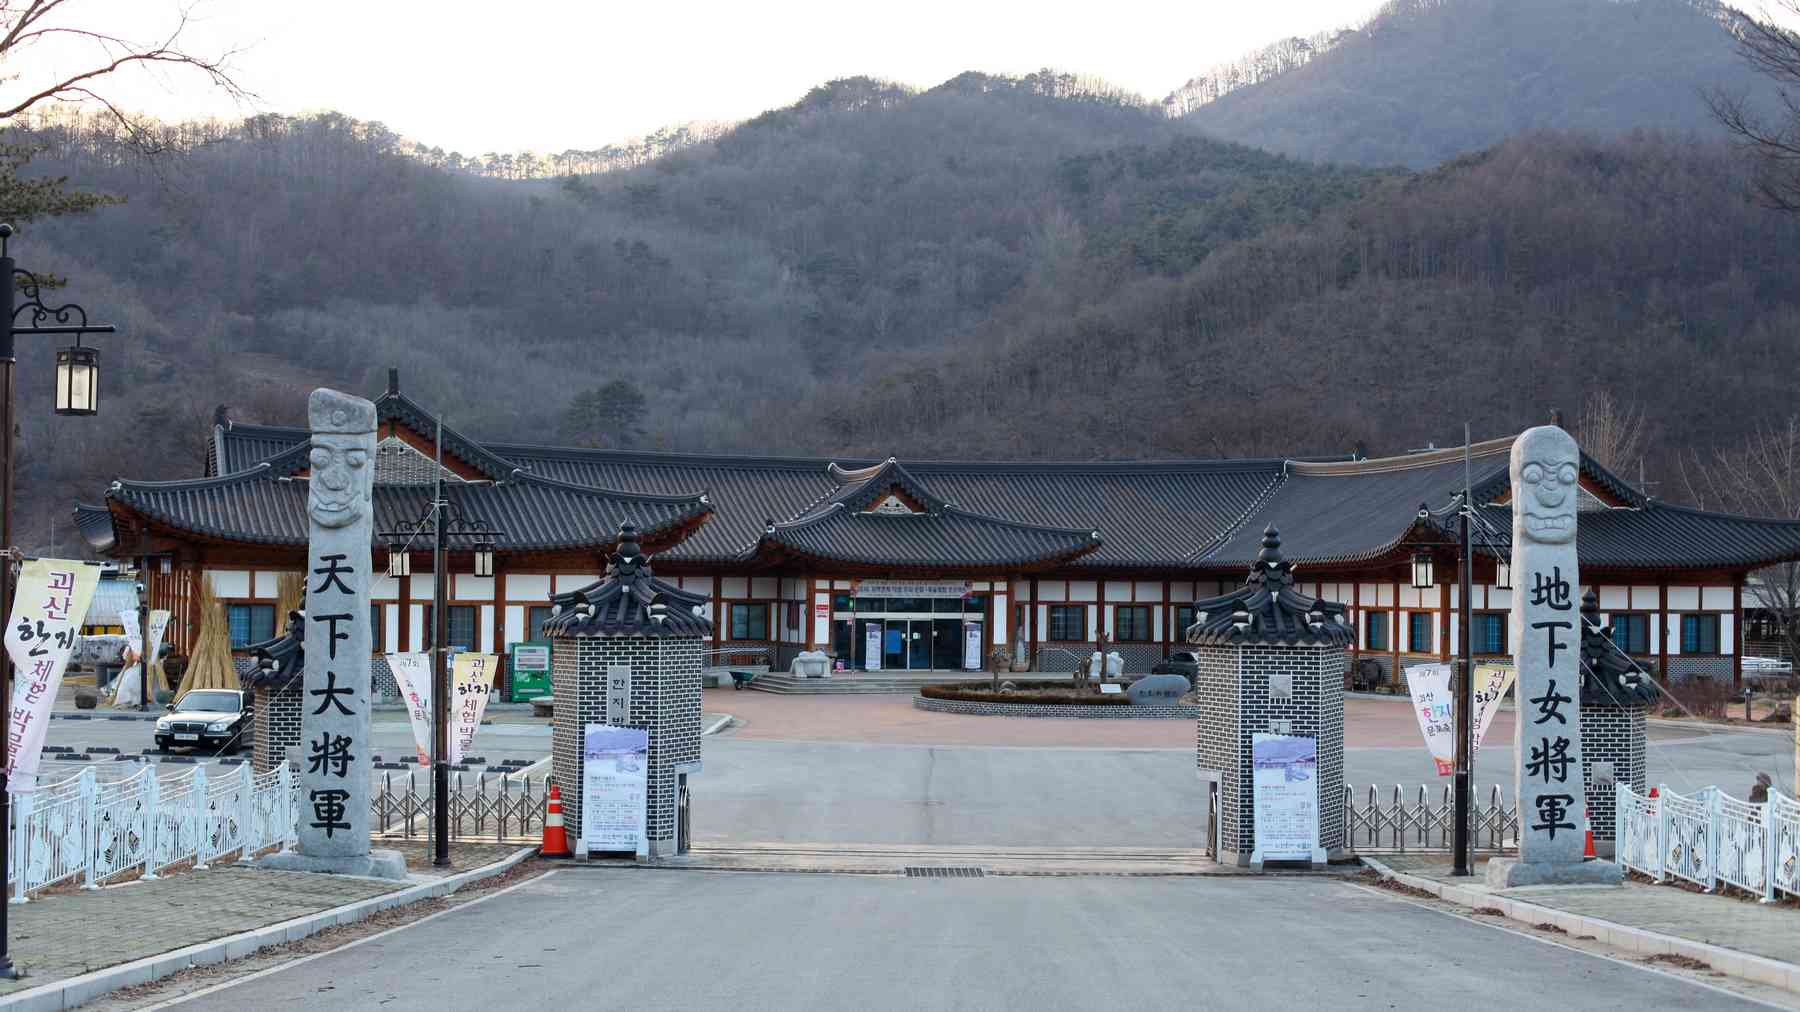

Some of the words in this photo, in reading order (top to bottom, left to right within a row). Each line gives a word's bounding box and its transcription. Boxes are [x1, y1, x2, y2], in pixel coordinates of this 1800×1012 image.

[17, 616, 75, 657] 한지
[43, 572, 75, 621] 괴산
[308, 554, 356, 839] 天下大將軍
[1525, 566, 1577, 841] 地下女將軍
